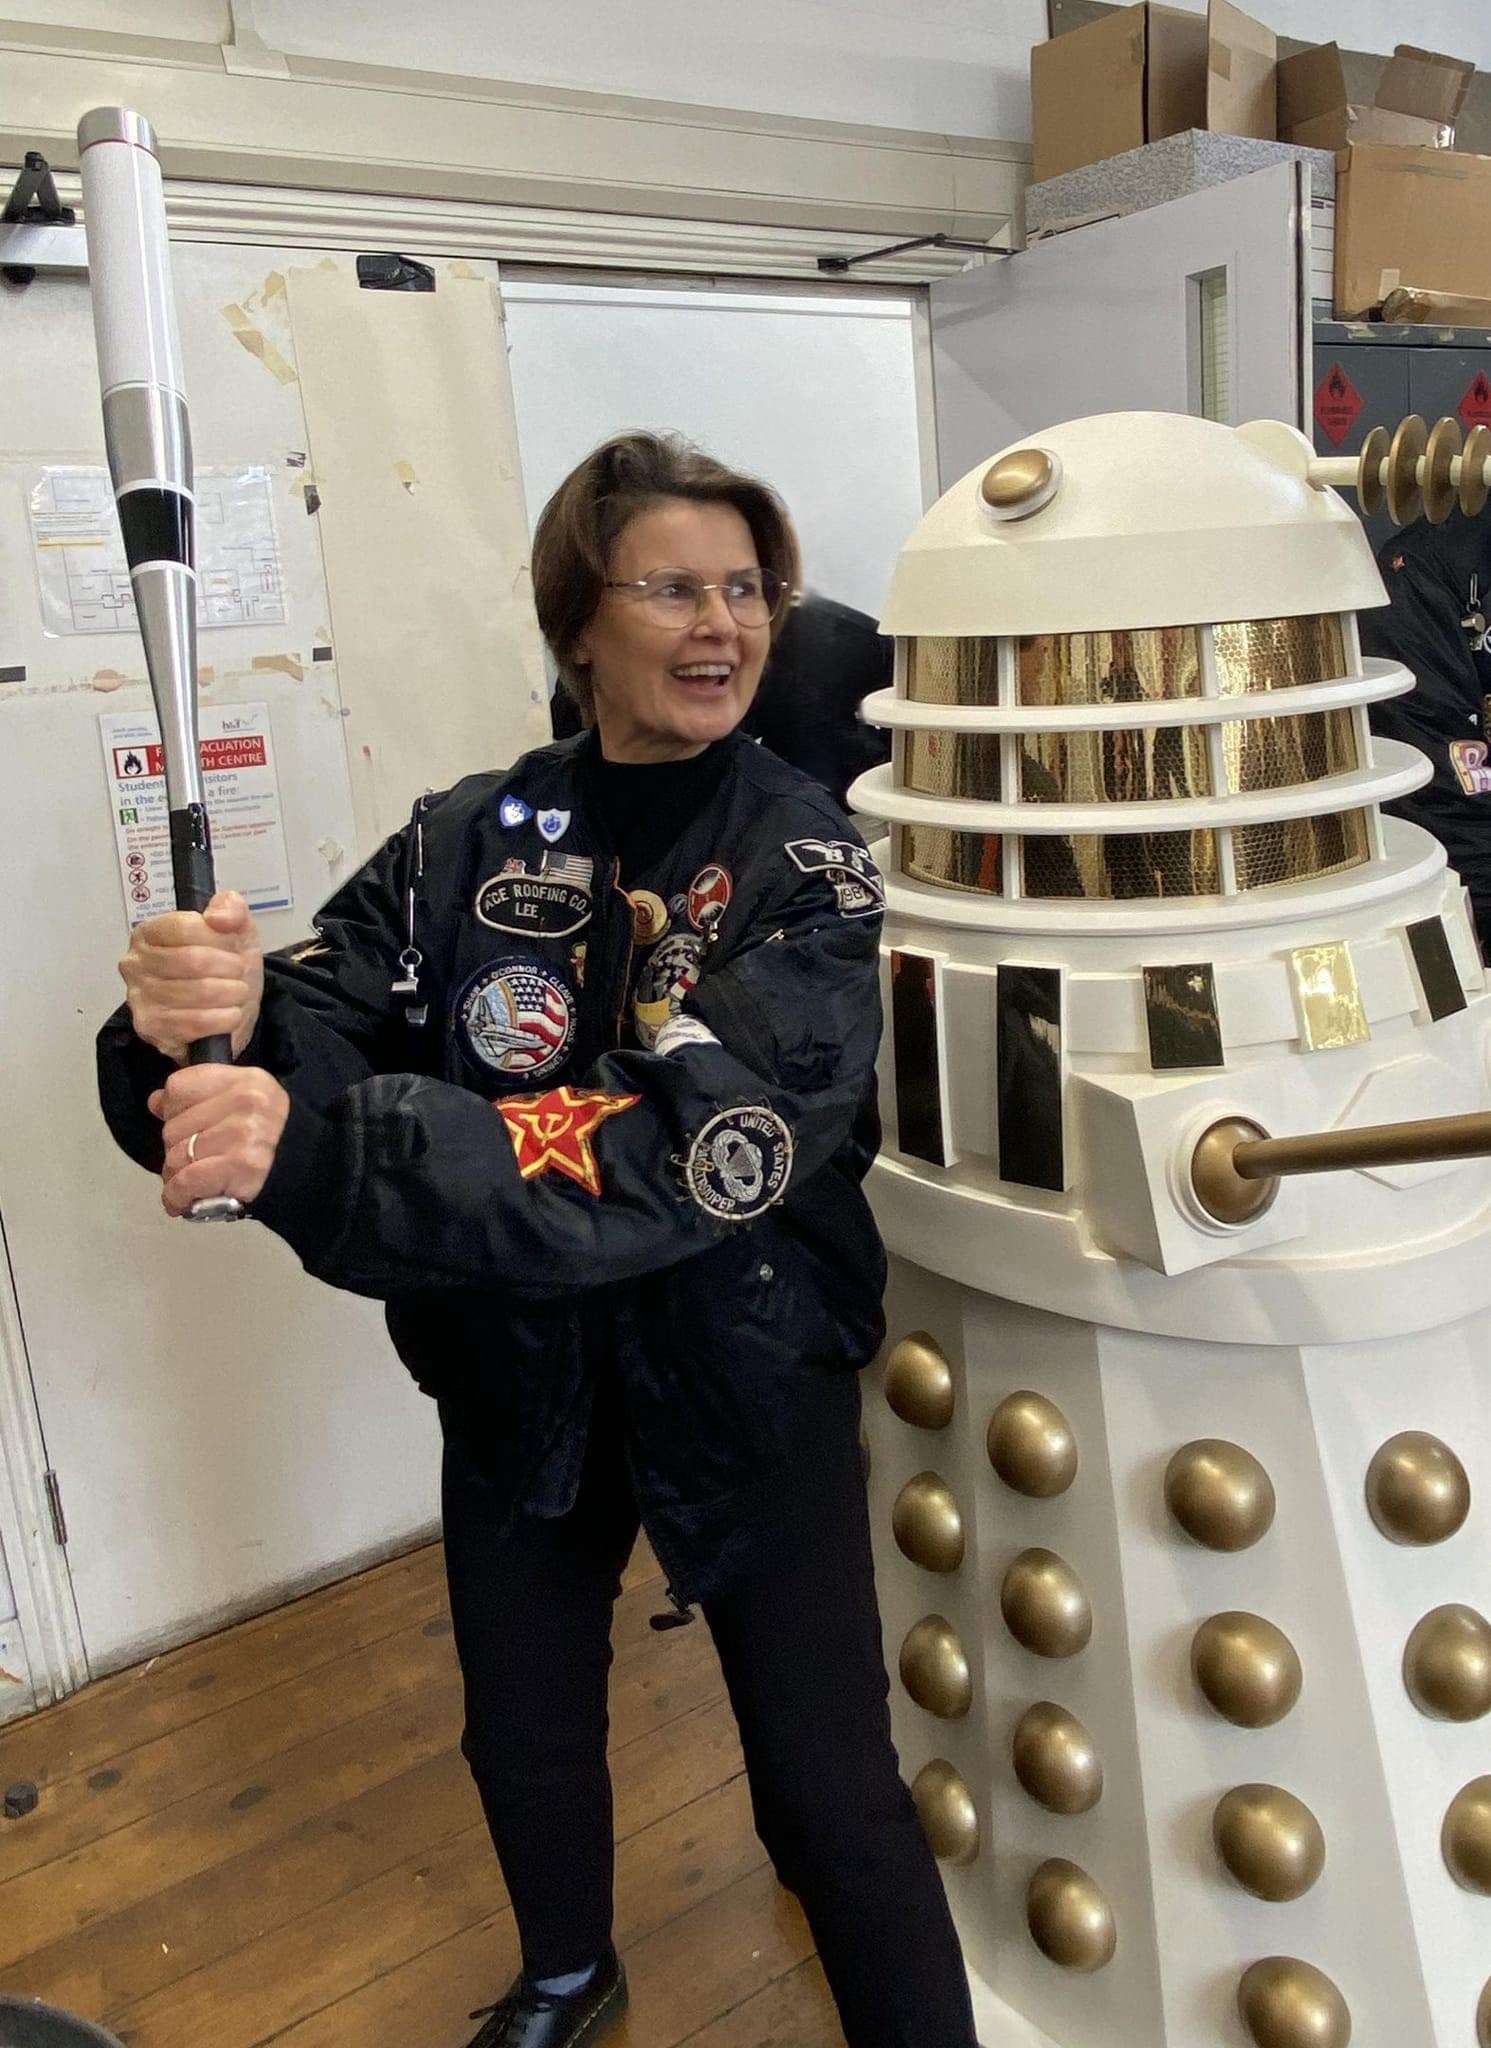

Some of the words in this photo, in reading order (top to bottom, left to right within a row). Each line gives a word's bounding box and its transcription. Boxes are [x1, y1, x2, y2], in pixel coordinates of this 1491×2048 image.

[200, 738, 262, 753] ACUATION
[218, 752, 263, 767] CENTRE
[118, 779, 165, 792] Student
[204, 772, 238, 785] isitors
[120, 796, 132, 807] in
[135, 793, 155, 804] the
[207, 789, 215, 798] a
[484, 887, 510, 911] ACE
[512, 884, 568, 904] ROOFING
[569, 894, 589, 914] CO.
[514, 902, 539, 918] LEE
[740, 1114, 778, 1138] UNITED
[767, 1142, 785, 1188] STATES
